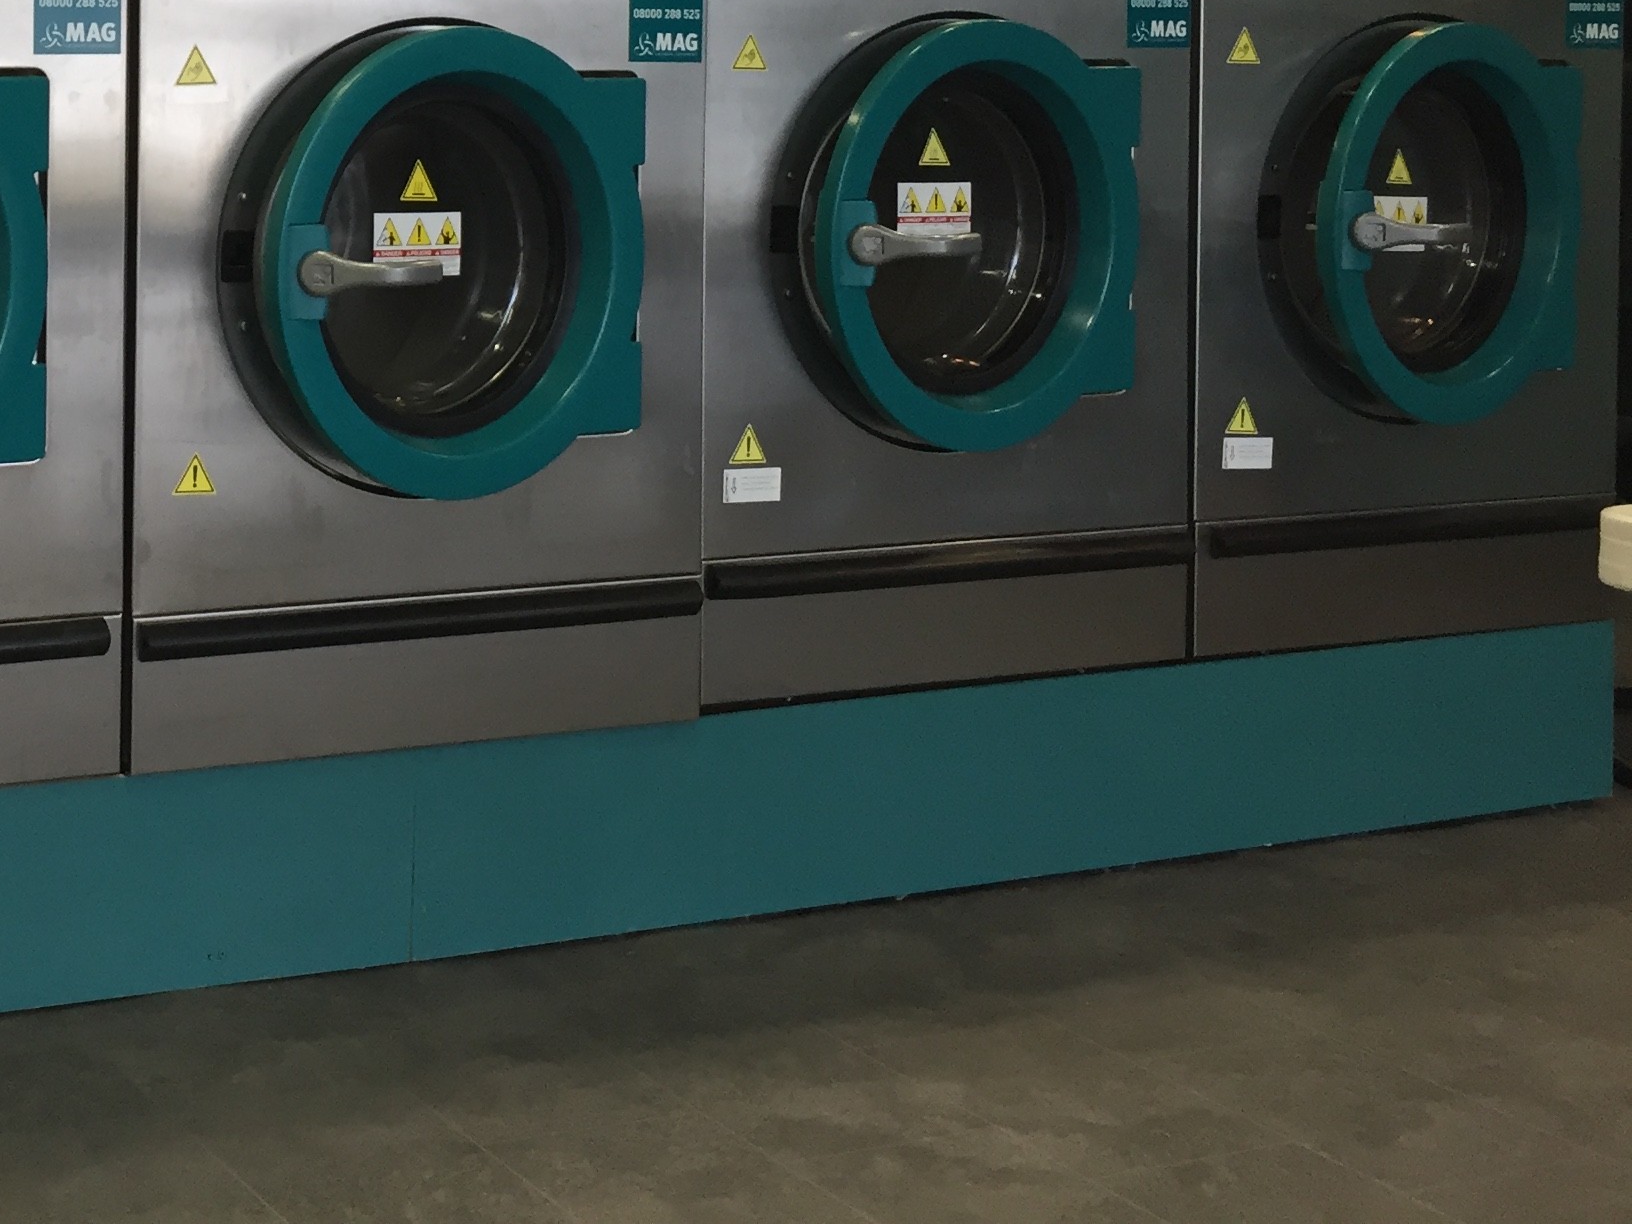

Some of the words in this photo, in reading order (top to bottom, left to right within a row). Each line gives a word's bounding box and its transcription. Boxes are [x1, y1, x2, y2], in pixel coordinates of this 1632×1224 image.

[633, 8, 662, 19] 08000
[664, 8, 681, 19] 288
[683, 9, 700, 19] 525
[65, 22, 116, 42] MAG
[1150, 20, 1187, 37] MAG
[1586, 23, 1619, 39] MAG
[656, 32, 698, 51] MAG
